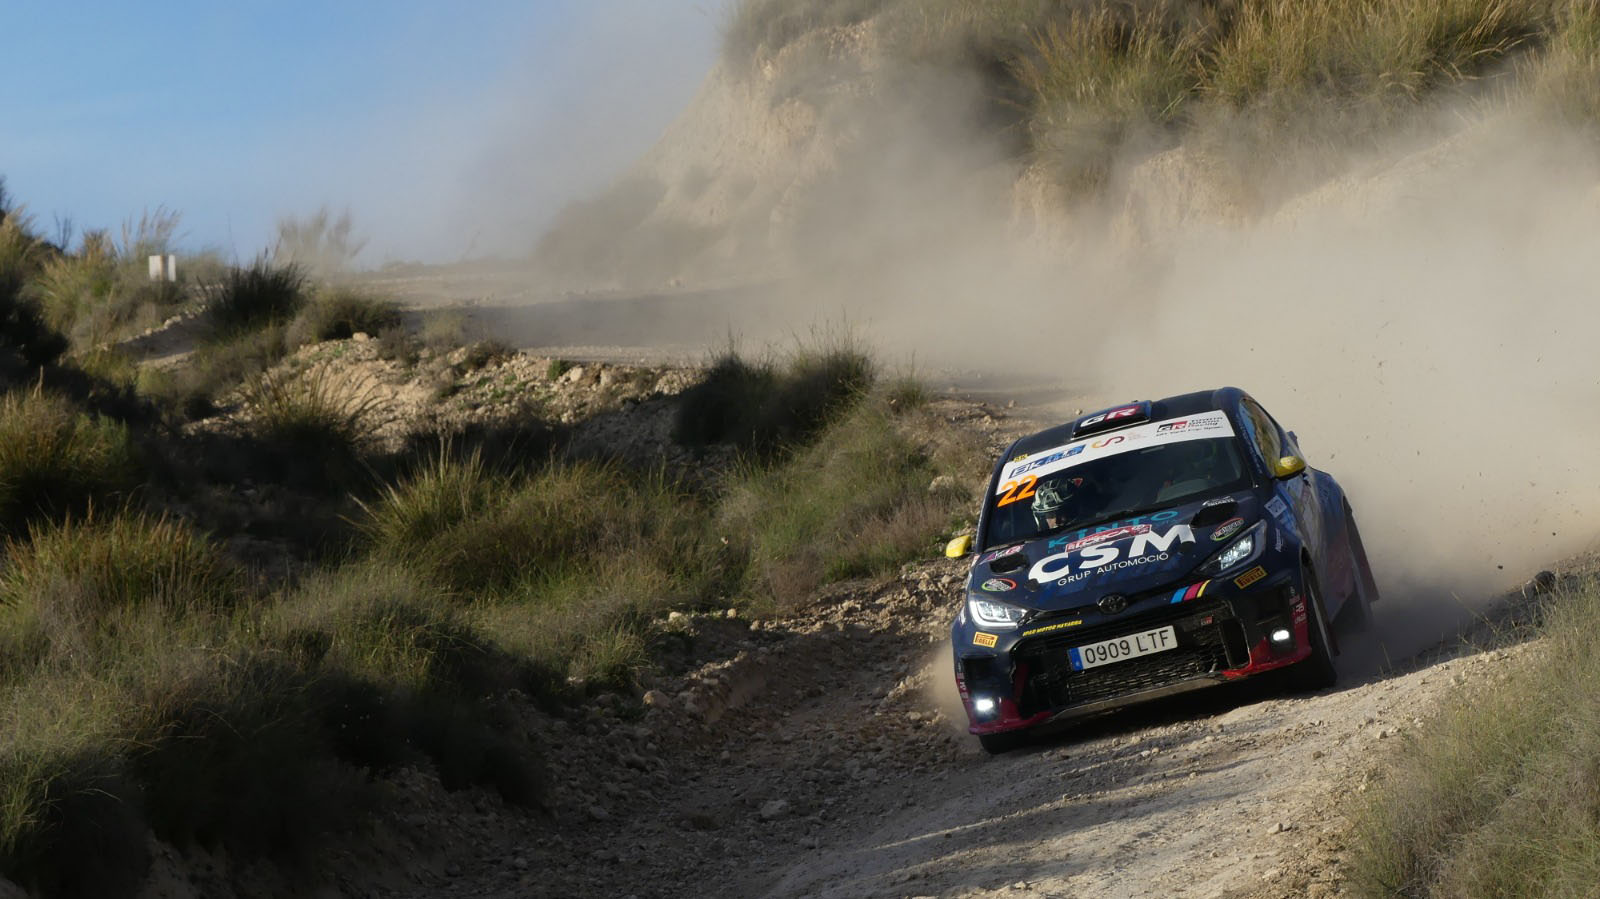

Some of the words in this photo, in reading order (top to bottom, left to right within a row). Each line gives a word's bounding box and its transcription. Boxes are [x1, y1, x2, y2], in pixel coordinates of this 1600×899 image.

[1080, 406, 1139, 428] GR
[997, 474, 1038, 508] 22
[1047, 510, 1179, 549] KINTO
[1028, 524, 1197, 584] CSM
[1057, 570, 1091, 586] GRUP
[1097, 551, 1169, 575] AUTOMOCIÓ
[1084, 640, 1130, 664] 0909
[1136, 629, 1169, 652] LTF
